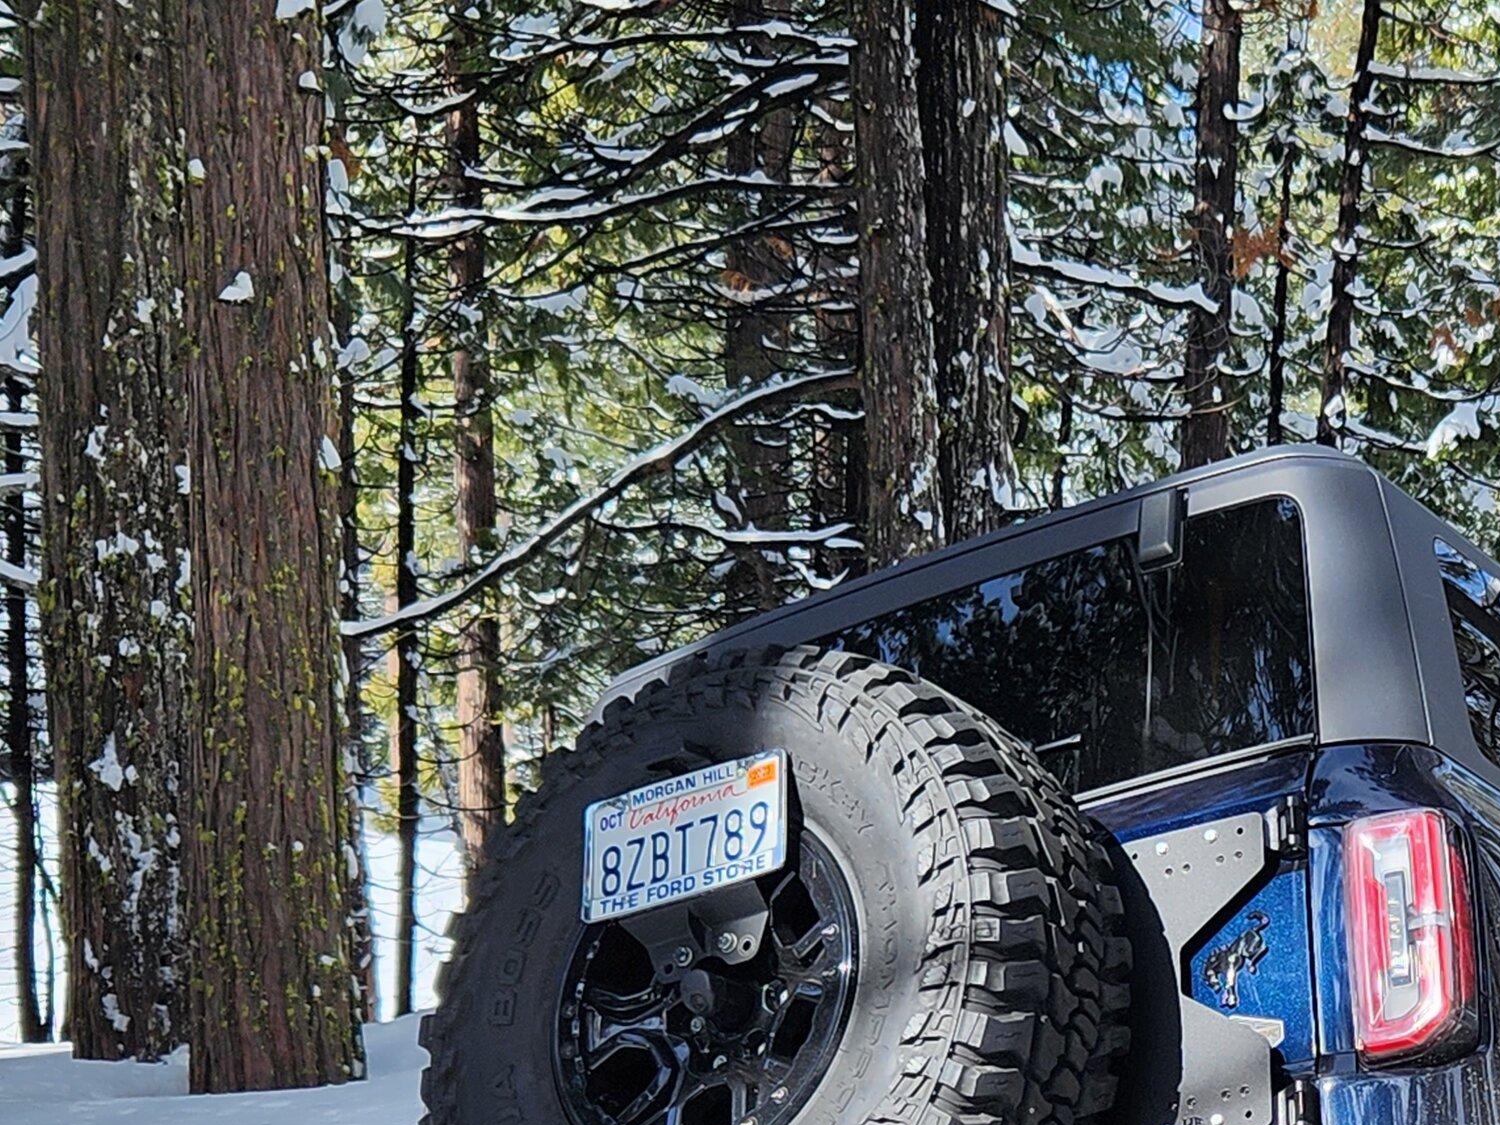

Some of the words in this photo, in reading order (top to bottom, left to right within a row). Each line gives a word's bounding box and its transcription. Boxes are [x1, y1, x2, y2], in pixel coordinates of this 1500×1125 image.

[630, 784, 747, 829] California
[632, 775, 696, 806] MORGAN
[703, 766, 734, 785] HILL
[600, 813, 624, 832] OCT
[601, 801, 769, 897] 8ZBT789
[600, 893, 638, 914] THE
[647, 875, 696, 903] FORD
[703, 854, 765, 886] STORE
[489, 872, 561, 1027] BOSS
